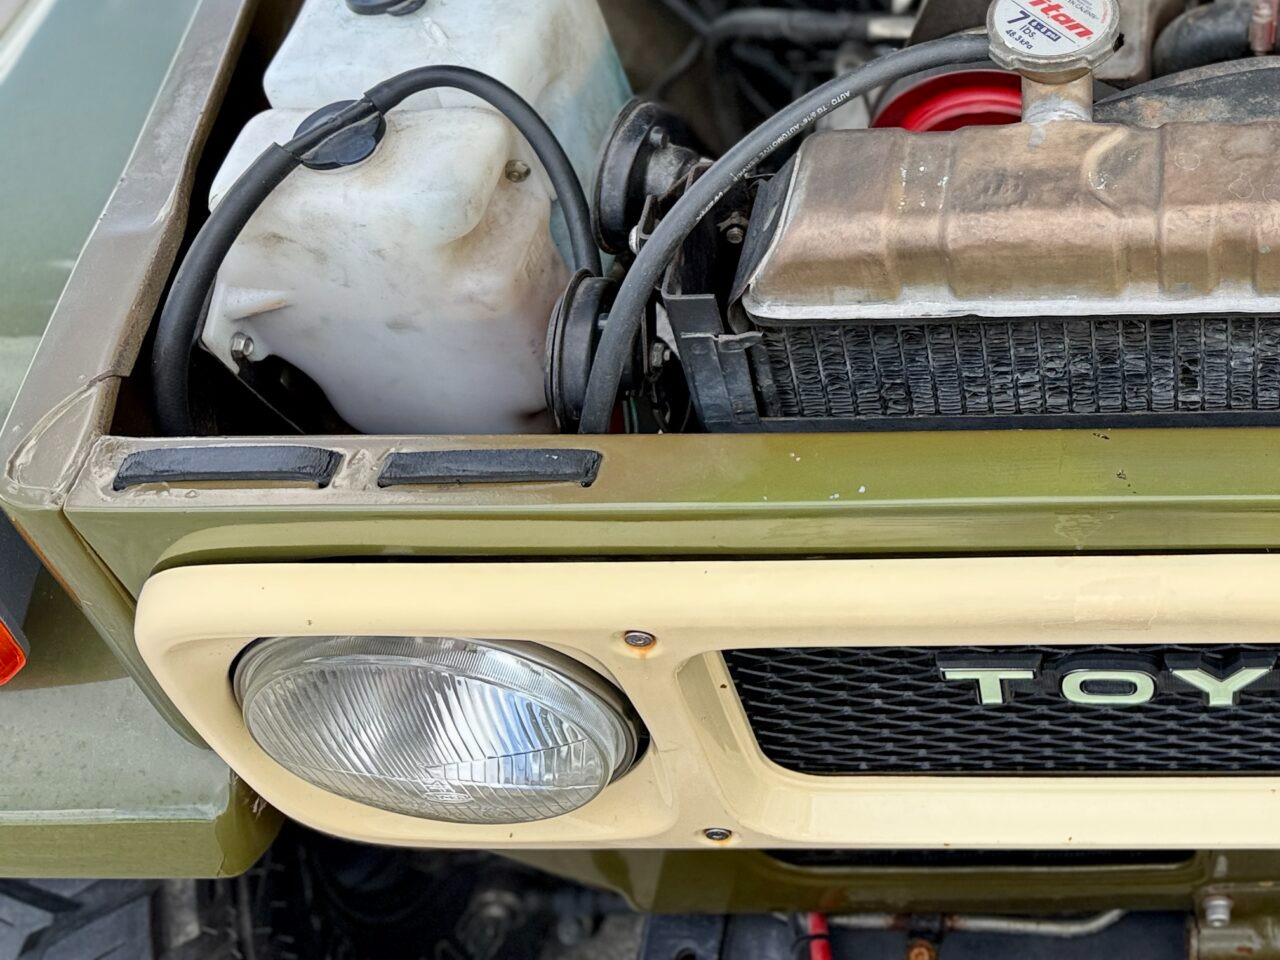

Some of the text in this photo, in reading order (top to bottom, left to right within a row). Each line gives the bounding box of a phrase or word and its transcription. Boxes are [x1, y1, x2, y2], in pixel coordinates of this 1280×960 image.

[1007, 9, 1031, 25] 7
[830, 88, 852, 107] AUTO
[758, 122, 801, 161] AUTOMOTIVE
